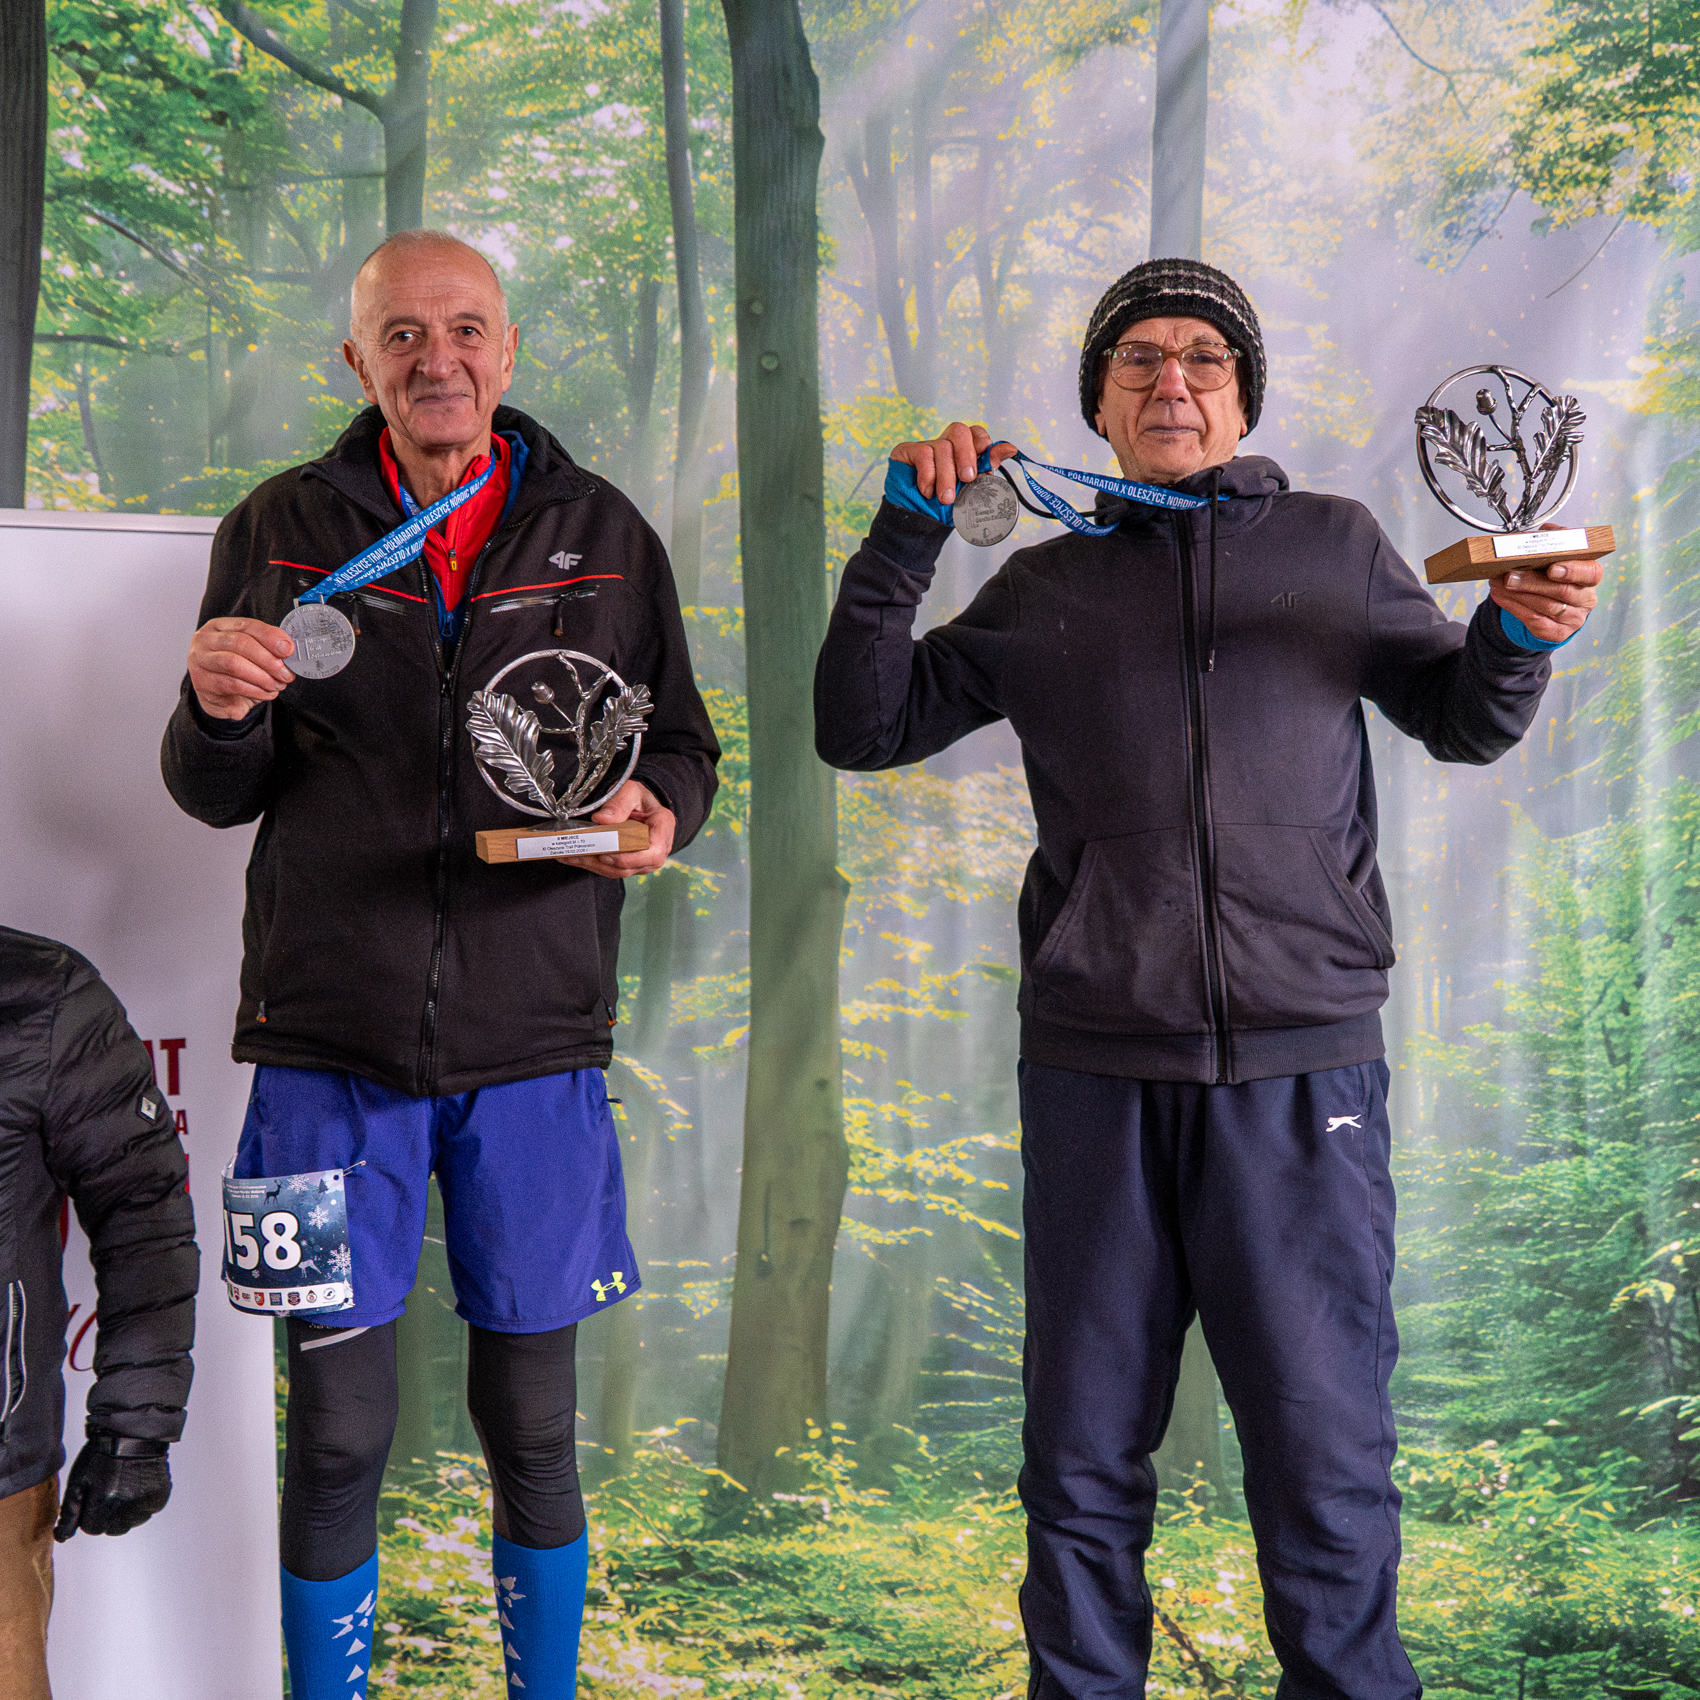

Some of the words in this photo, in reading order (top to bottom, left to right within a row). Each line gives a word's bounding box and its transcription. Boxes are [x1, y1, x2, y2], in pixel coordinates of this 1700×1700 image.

[1028, 479, 1053, 502] NORDIC
[1068, 471, 1120, 493] PÓŁMARATON
[1119, 483, 1127, 495] X
[1127, 486, 1167, 505] OLESZYCE
[1166, 495, 1197, 508] NORDIC
[1049, 497, 1083, 528] OLESZYCE
[341, 556, 373, 581] OLESZYCE
[366, 547, 388, 564] TRAIL
[383, 523, 422, 553] PÓŁMARATON
[419, 519, 427, 530] X
[423, 501, 452, 526] OLESZYCE
[449, 488, 470, 509] NORDIC
[375, 549, 406, 572] OLESZYCE
[404, 546, 412, 557] X
[548, 550, 583, 570] 4F
